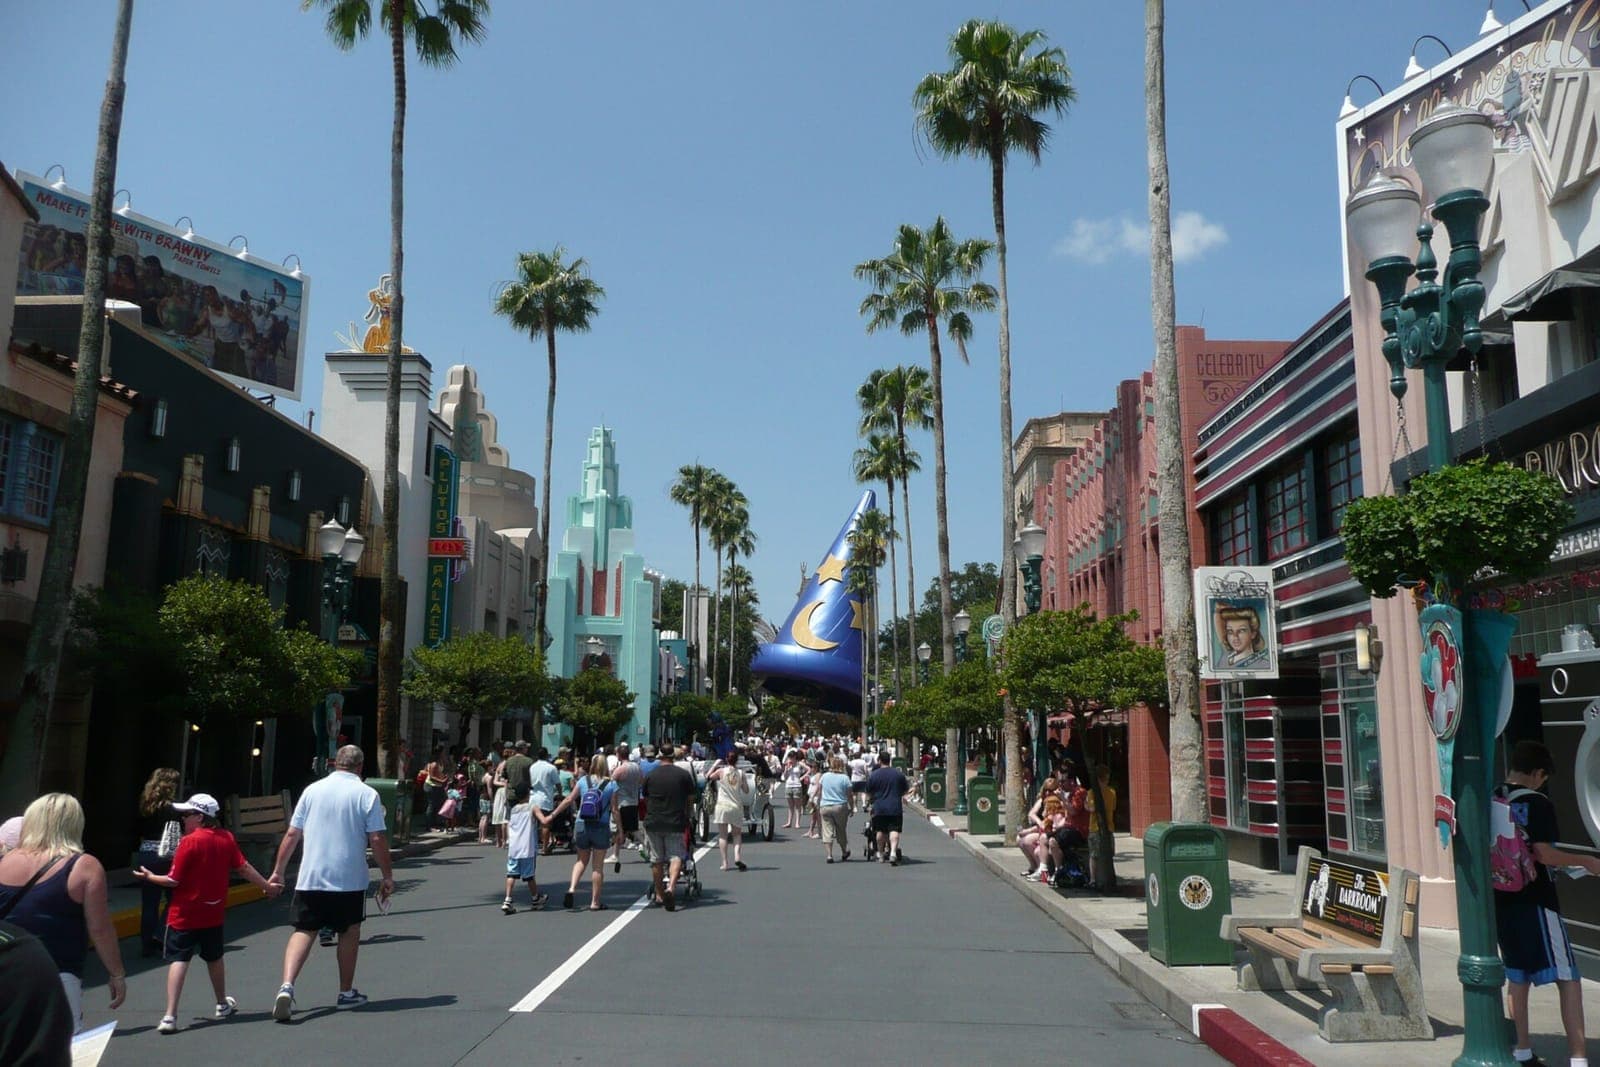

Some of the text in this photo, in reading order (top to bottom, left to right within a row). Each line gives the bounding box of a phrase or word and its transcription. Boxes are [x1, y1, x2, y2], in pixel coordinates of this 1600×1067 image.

[1352, 18, 1556, 189] Hollwood
[75, 204, 88, 219] IT
[155, 234, 213, 261] BRAWNY
[1196, 353, 1265, 377] CELEBRITY
[430, 564, 443, 640] PALACE
[1339, 887, 1377, 914] DARKROOM
